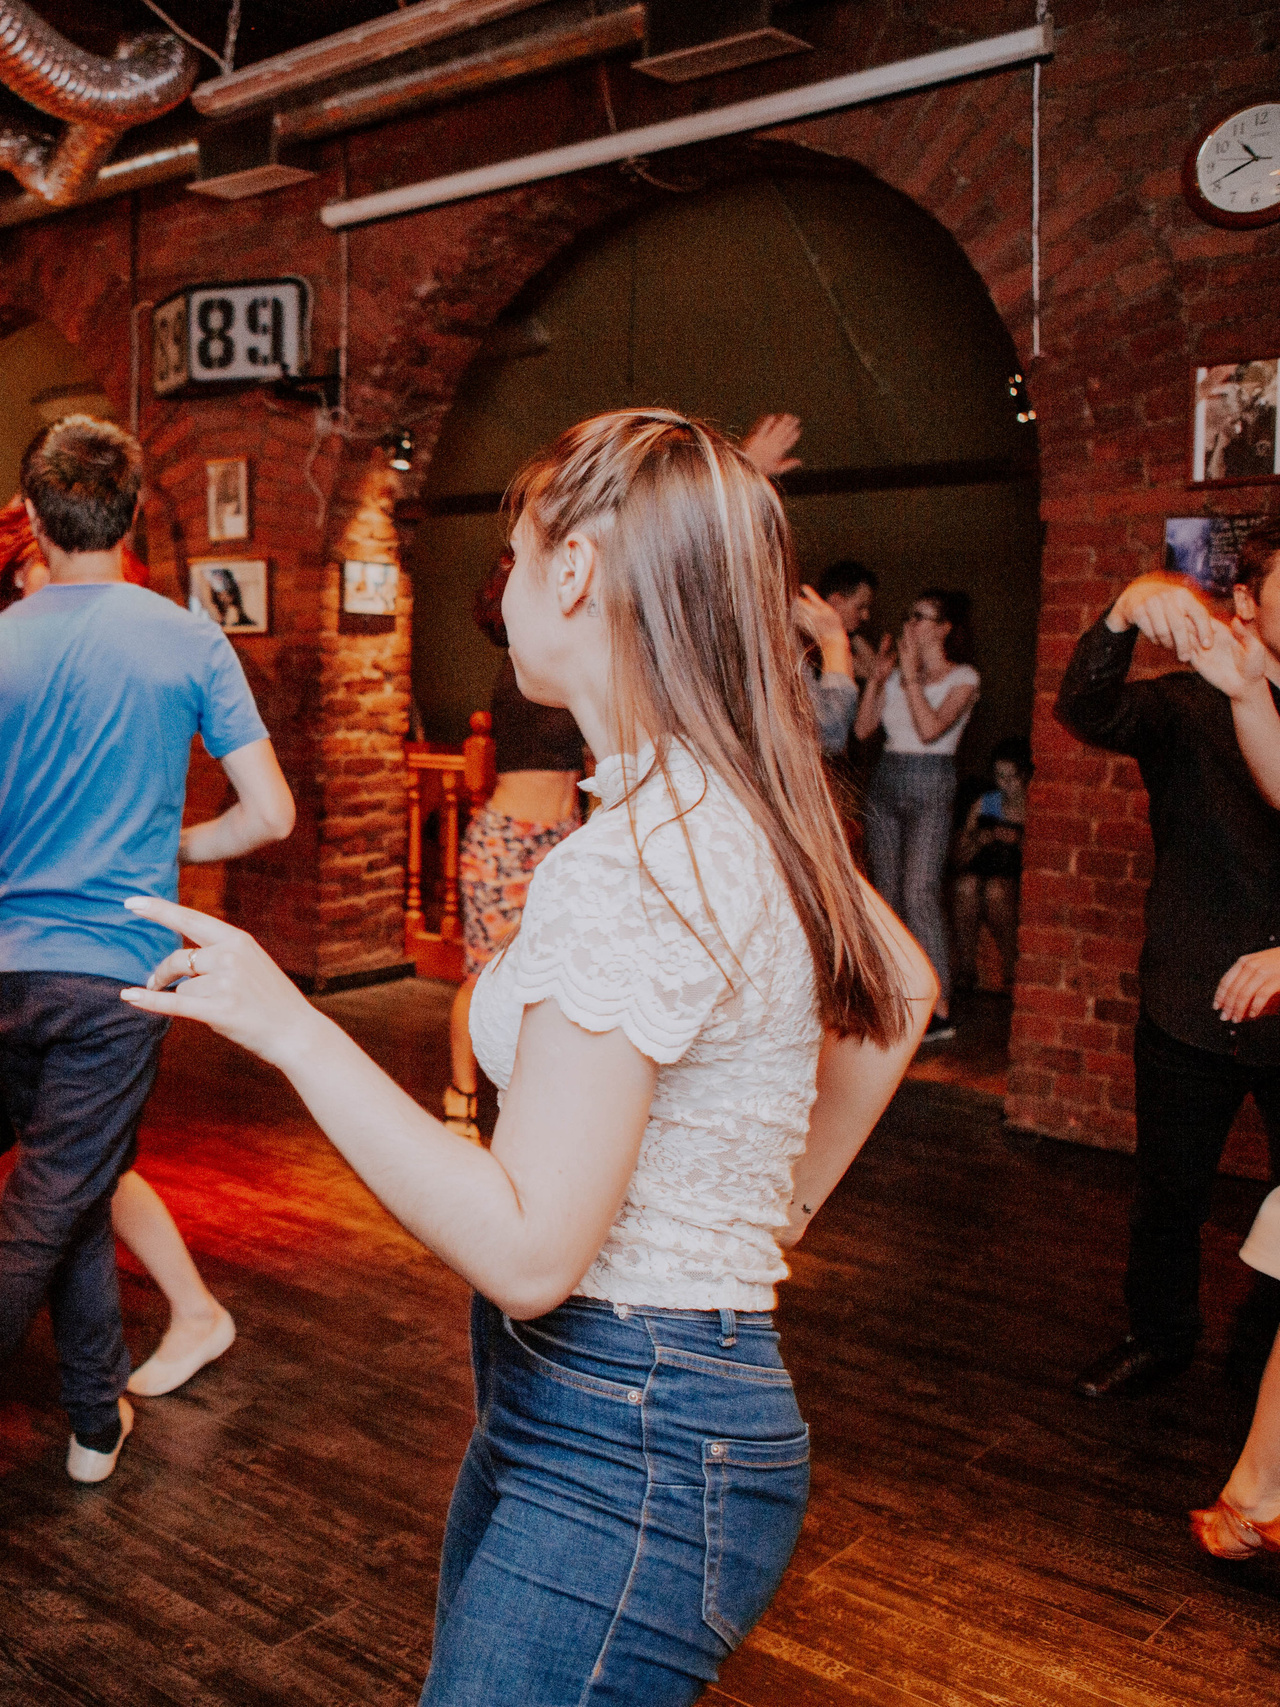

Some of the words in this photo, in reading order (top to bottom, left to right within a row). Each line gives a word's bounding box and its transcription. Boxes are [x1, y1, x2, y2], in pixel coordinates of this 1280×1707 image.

[1254, 111, 1268, 126] 12
[1232, 122, 1245, 137] 11
[1215, 140, 1230, 154] 10
[1250, 192, 1260, 205] 6
[197, 297, 284, 370] 89
